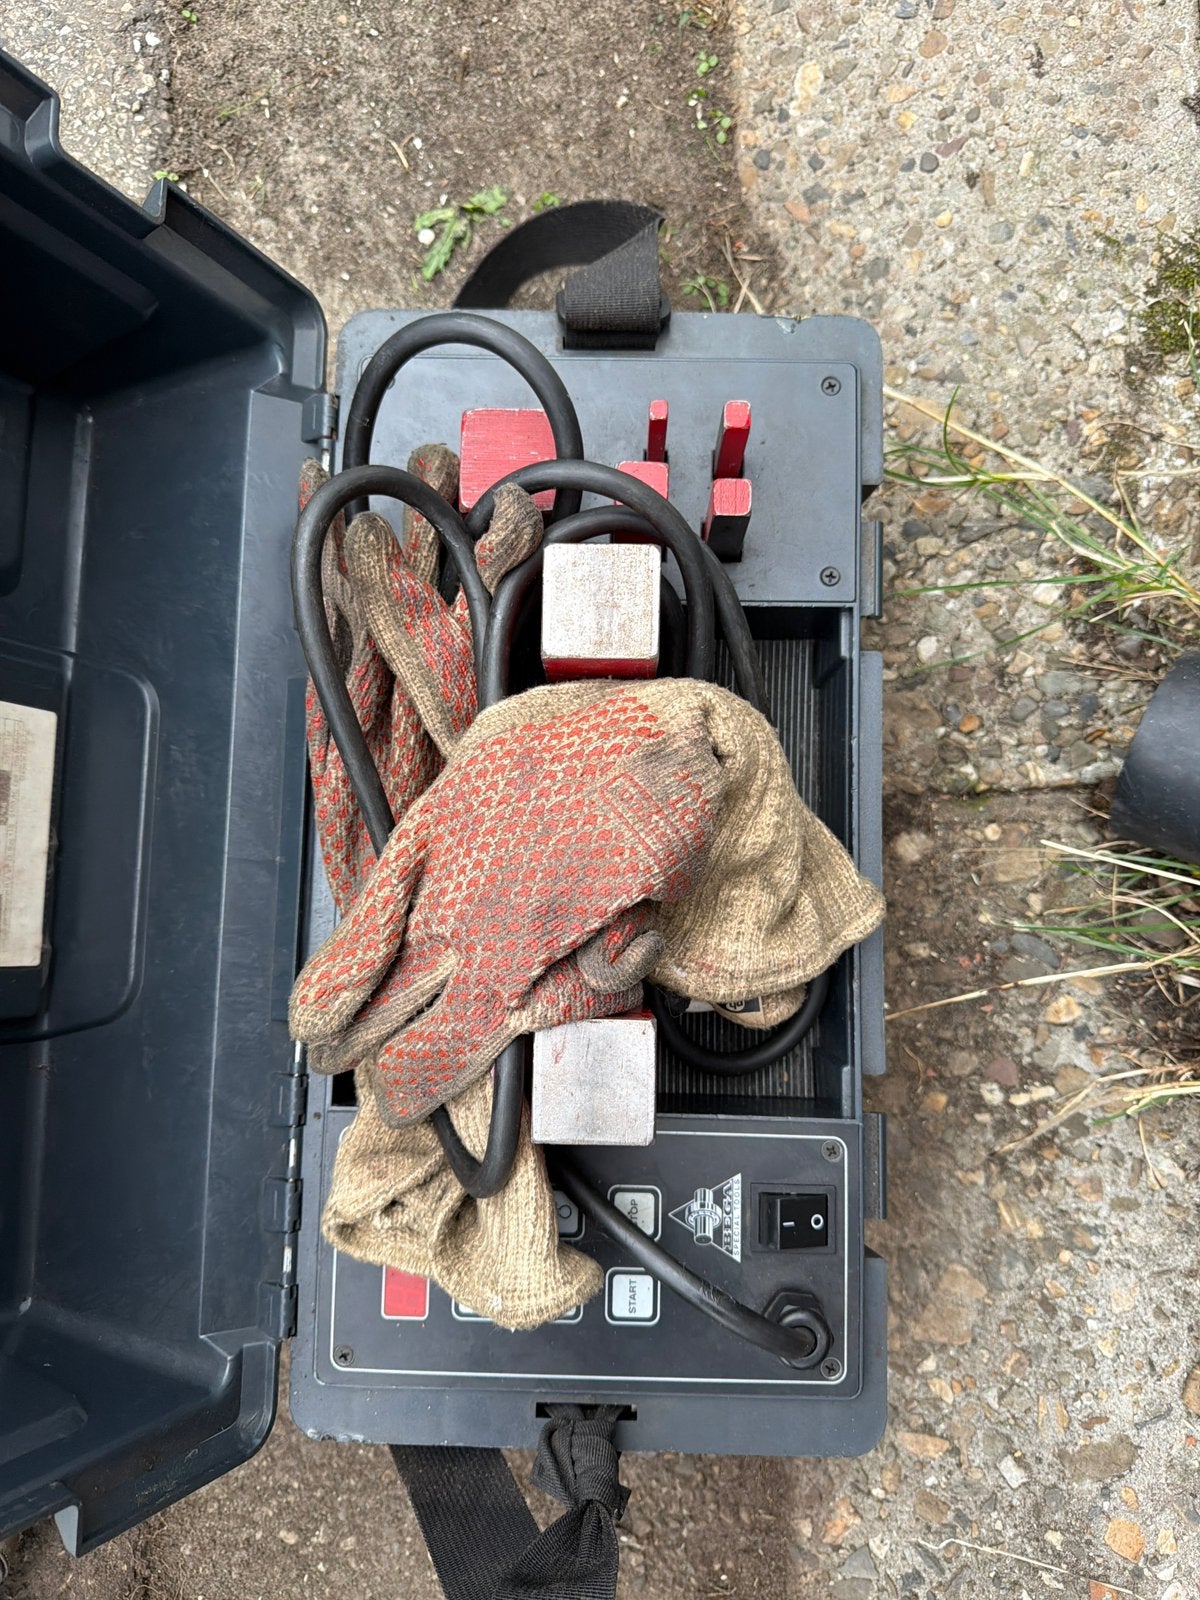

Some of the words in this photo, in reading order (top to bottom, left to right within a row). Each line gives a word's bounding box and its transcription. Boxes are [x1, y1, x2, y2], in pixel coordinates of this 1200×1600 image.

[630, 1199, 639, 1226] TOP
[723, 1179, 733, 1249] BEGA
[628, 1278, 637, 1314] START
